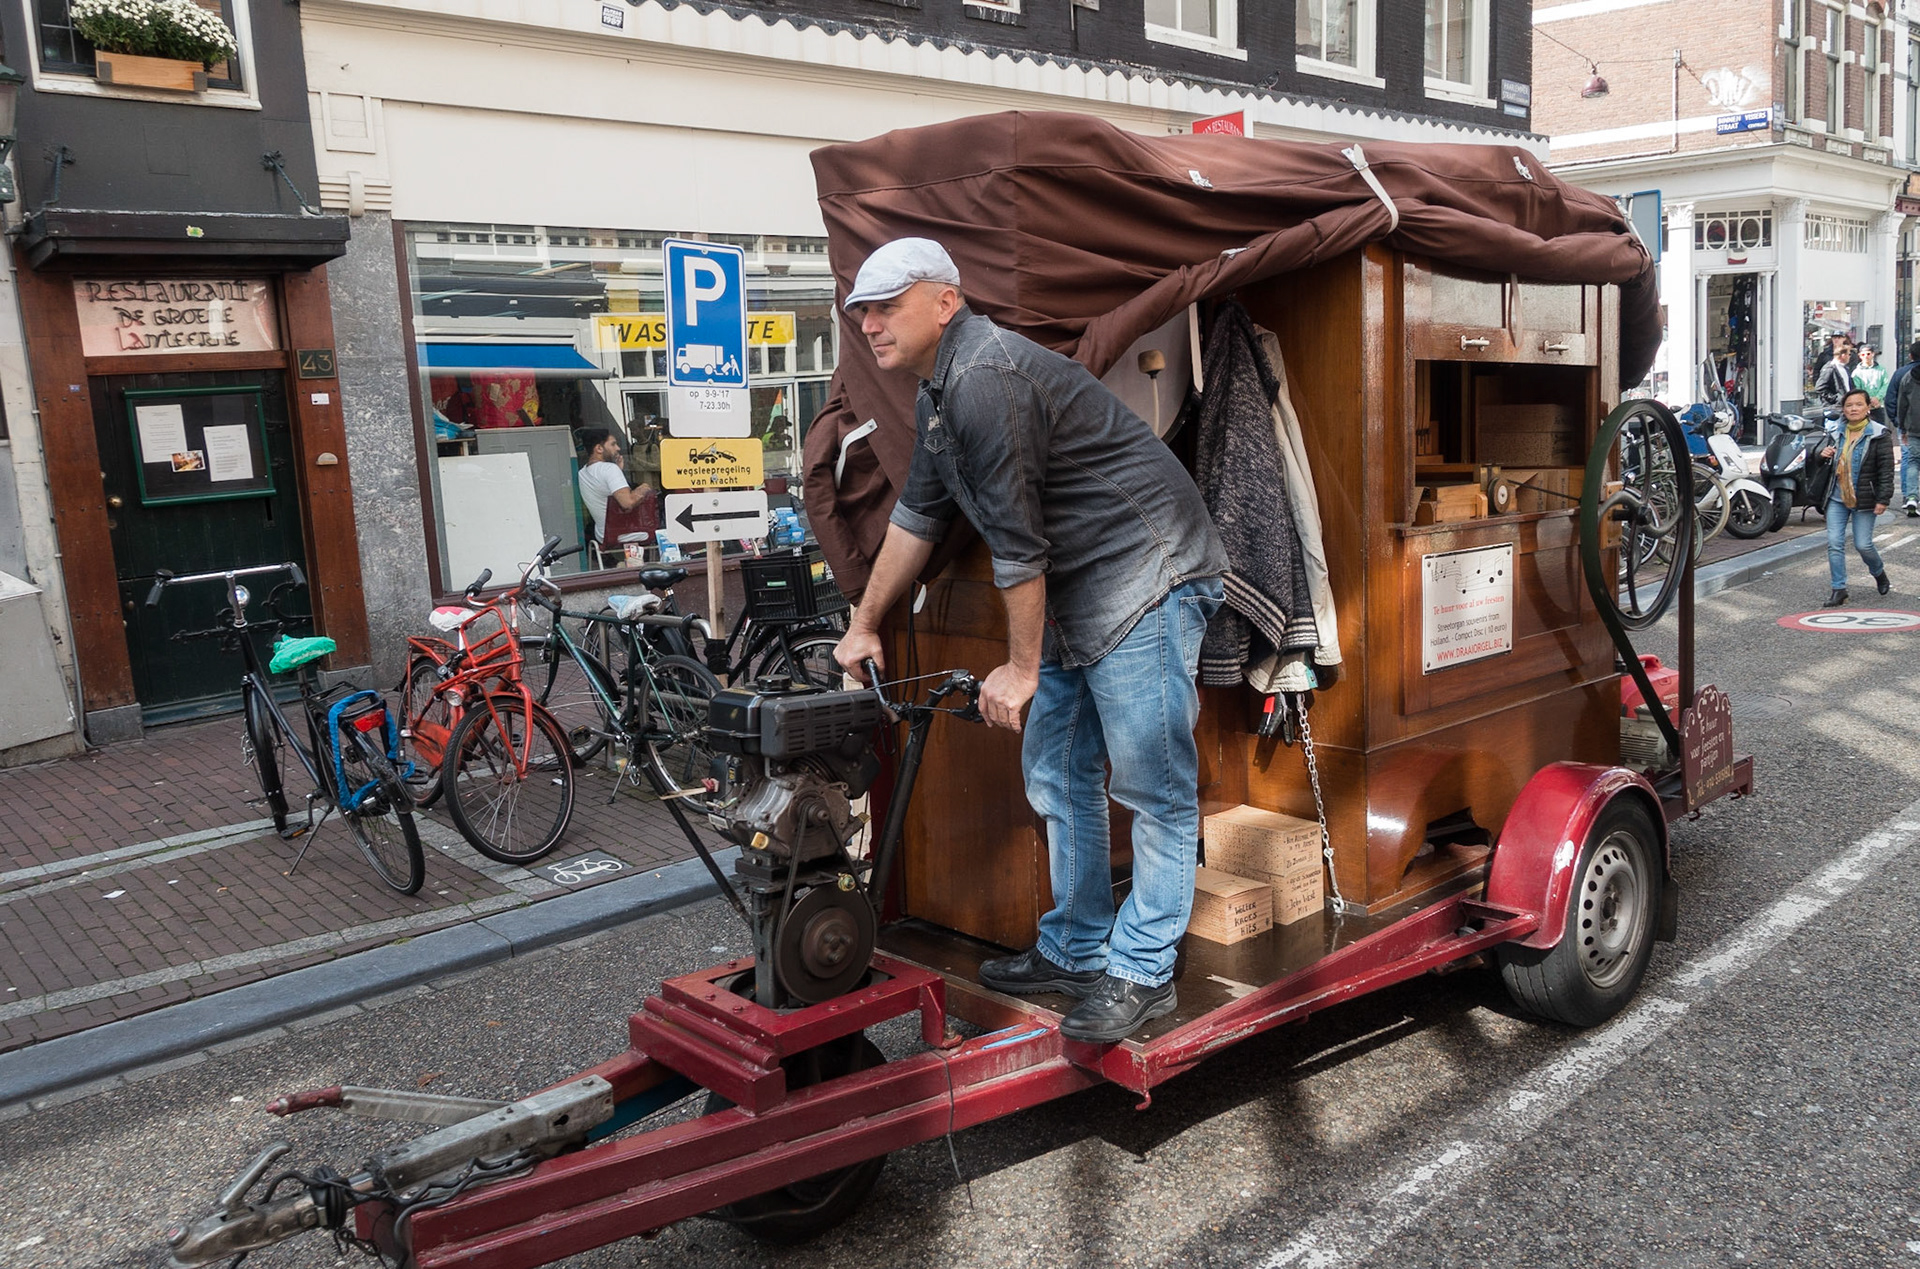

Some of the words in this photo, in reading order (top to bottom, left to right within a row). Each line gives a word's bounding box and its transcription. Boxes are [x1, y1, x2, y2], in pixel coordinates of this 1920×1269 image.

[1718, 115, 1742, 124] BINNEN
[1744, 111, 1767, 121] VISSERS
[1717, 122, 1739, 132] STRAAT
[85, 280, 250, 303] RESTAURANT
[683, 255, 727, 326] P
[113, 306, 146, 328] DE
[301, 354, 333, 373] 43
[689, 390, 699, 399] op
[699, 401, 731, 410] 7-23.30h
[676, 465, 751, 477] wegsleepregeling
[691, 478, 707, 486] van
[1433, 605, 1440, 615] Te
[1455, 602, 1468, 610] voor
[1469, 599, 1474, 608] al
[1484, 595, 1505, 605] feesten
[1437, 620, 1466, 633] Streetorgan
[1465, 615, 1488, 626] souvenirs
[1488, 613, 1500, 621] from
[1454, 630, 1474, 641] Compact
[1474, 628, 1484, 637] Disc
[1436, 637, 1504, 662] WWW.DRAAIORGEL.BIZ
